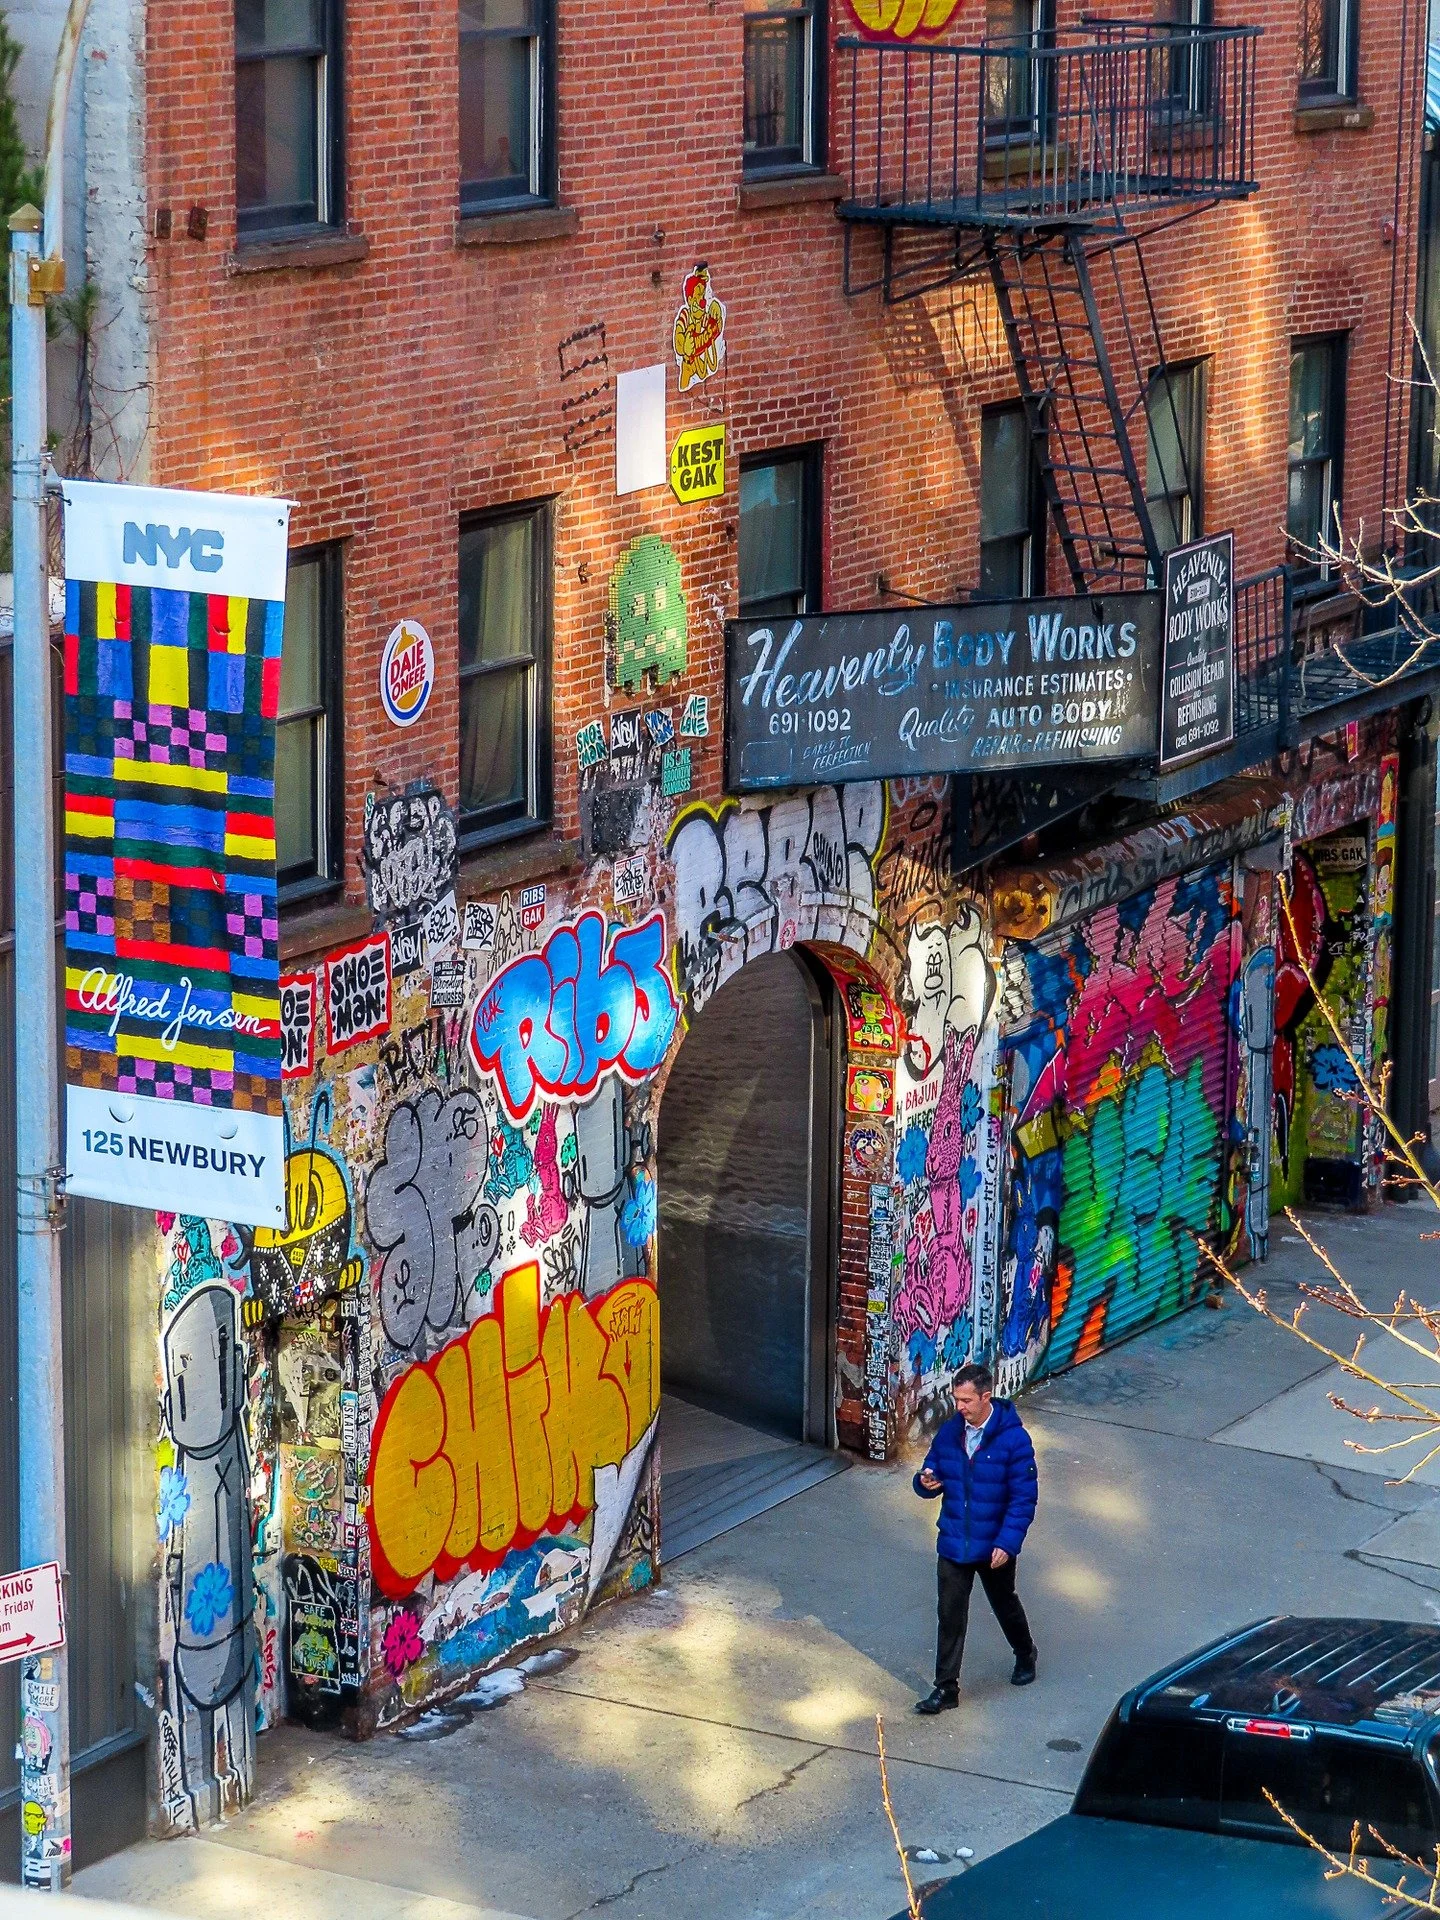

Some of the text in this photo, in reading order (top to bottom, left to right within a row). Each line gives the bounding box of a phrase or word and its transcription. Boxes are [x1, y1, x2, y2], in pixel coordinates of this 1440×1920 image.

[677, 437, 724, 468] KEST
[679, 463, 718, 492] GAK
[123, 521, 225, 573] NYC
[1171, 550, 1227, 604] HEAVENLY
[1169, 596, 1228, 643] BODY WORKS
[739, 620, 927, 708] Heavenly
[1169, 660, 1225, 699] COLLISION REPAIR
[944, 669, 1125, 700] INSURANCE ESTIMATES
[898, 699, 1112, 752] Quality AUTO BODY
[1177, 694, 1217, 728] REFINISHING
[970, 733, 1022, 758] REPAIR
[1033, 725, 1123, 753] REFINISHING
[1188, 718, 1219, 744] 691-1092
[1341, 847, 1364, 862] GAK
[522, 886, 545, 906] RIBS
[523, 908, 544, 926] GAK
[78, 967, 171, 1037] Alfred
[161, 976, 272, 1052] Jensen
[82, 1129, 266, 1179] 125 NEWBURY
[343, 1404, 354, 1450] SKATCH
[4, 1599, 35, 1617] Friday
[303, 1604, 326, 1617] SAFE
